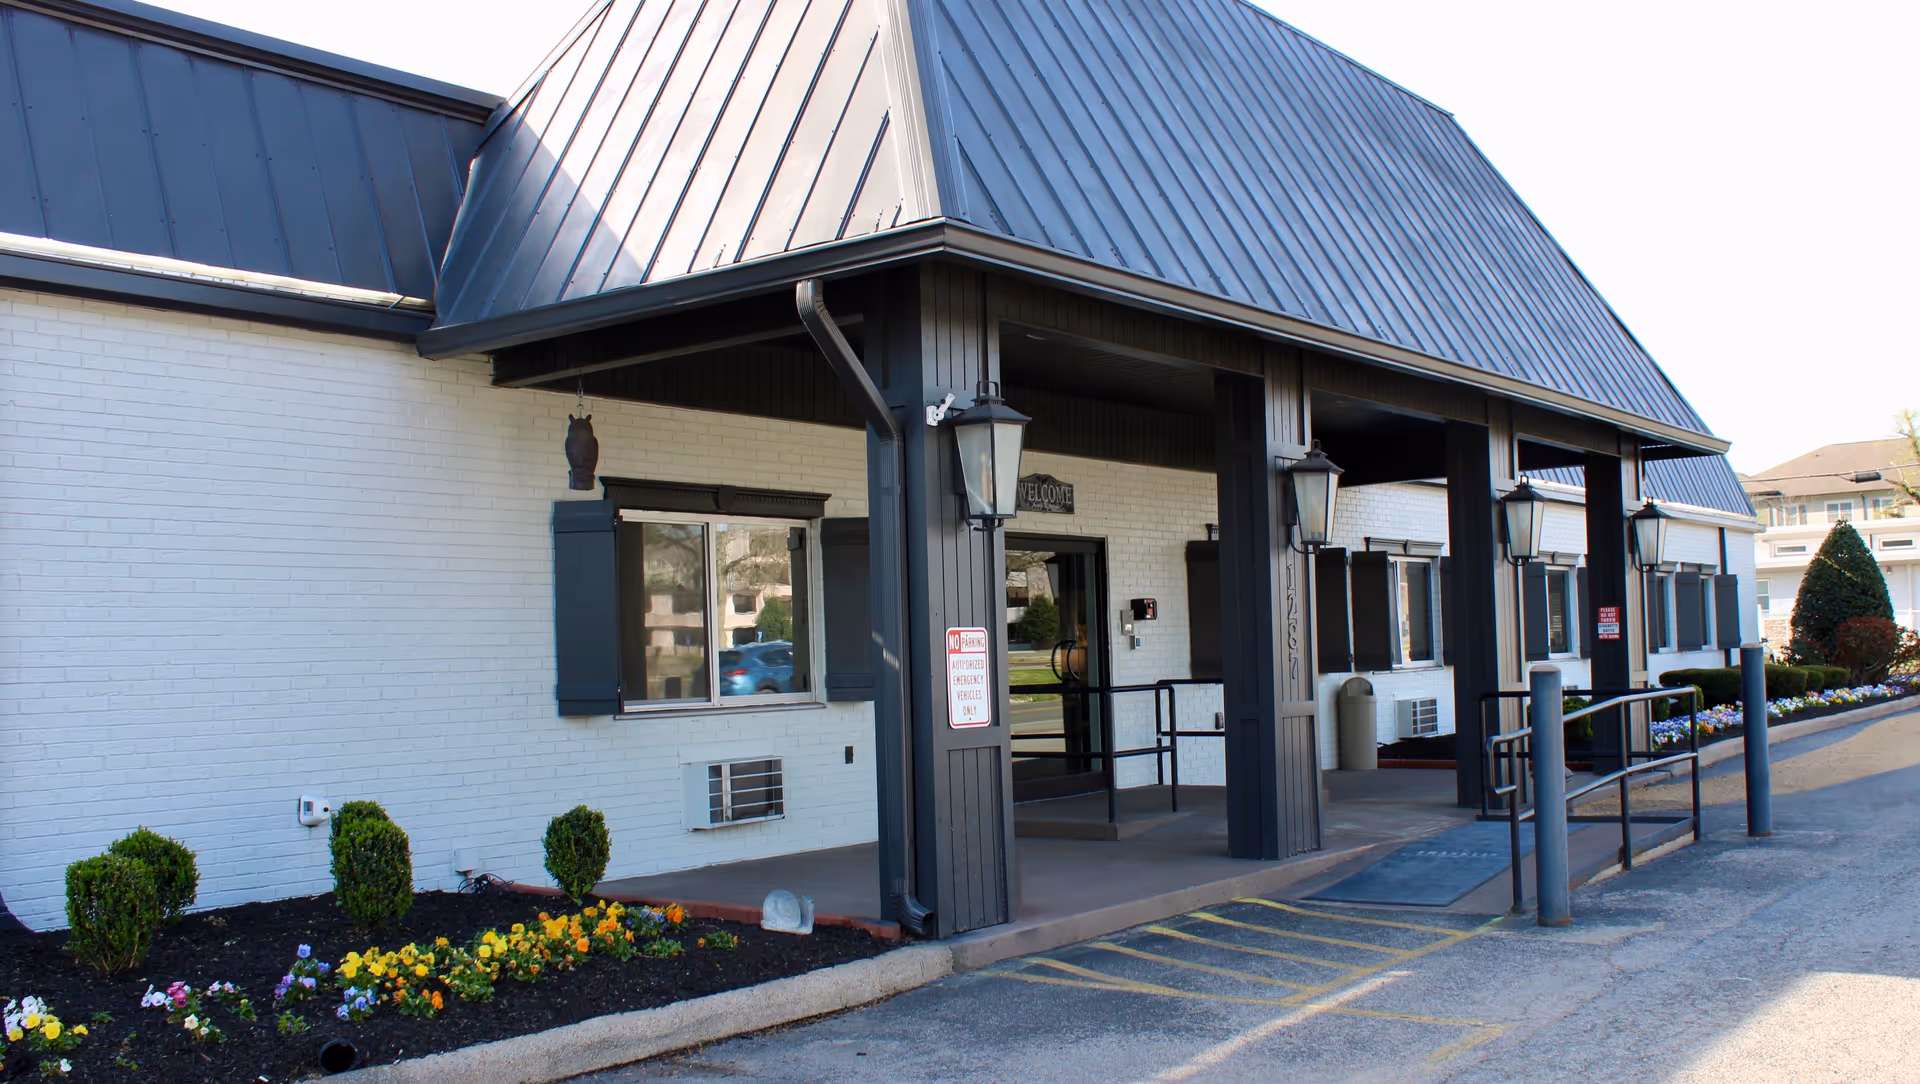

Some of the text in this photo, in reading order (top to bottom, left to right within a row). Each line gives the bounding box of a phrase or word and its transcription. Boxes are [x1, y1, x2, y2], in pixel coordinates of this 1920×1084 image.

[1018, 482, 1071, 504] WELCOME
[948, 634, 985, 650] NO PARKING
[952, 659, 985, 670] AUTHORIZED
[953, 674, 984, 686] EMERGENCY
[957, 689, 982, 701] VEHICLES
[962, 705, 977, 716] ONLY
